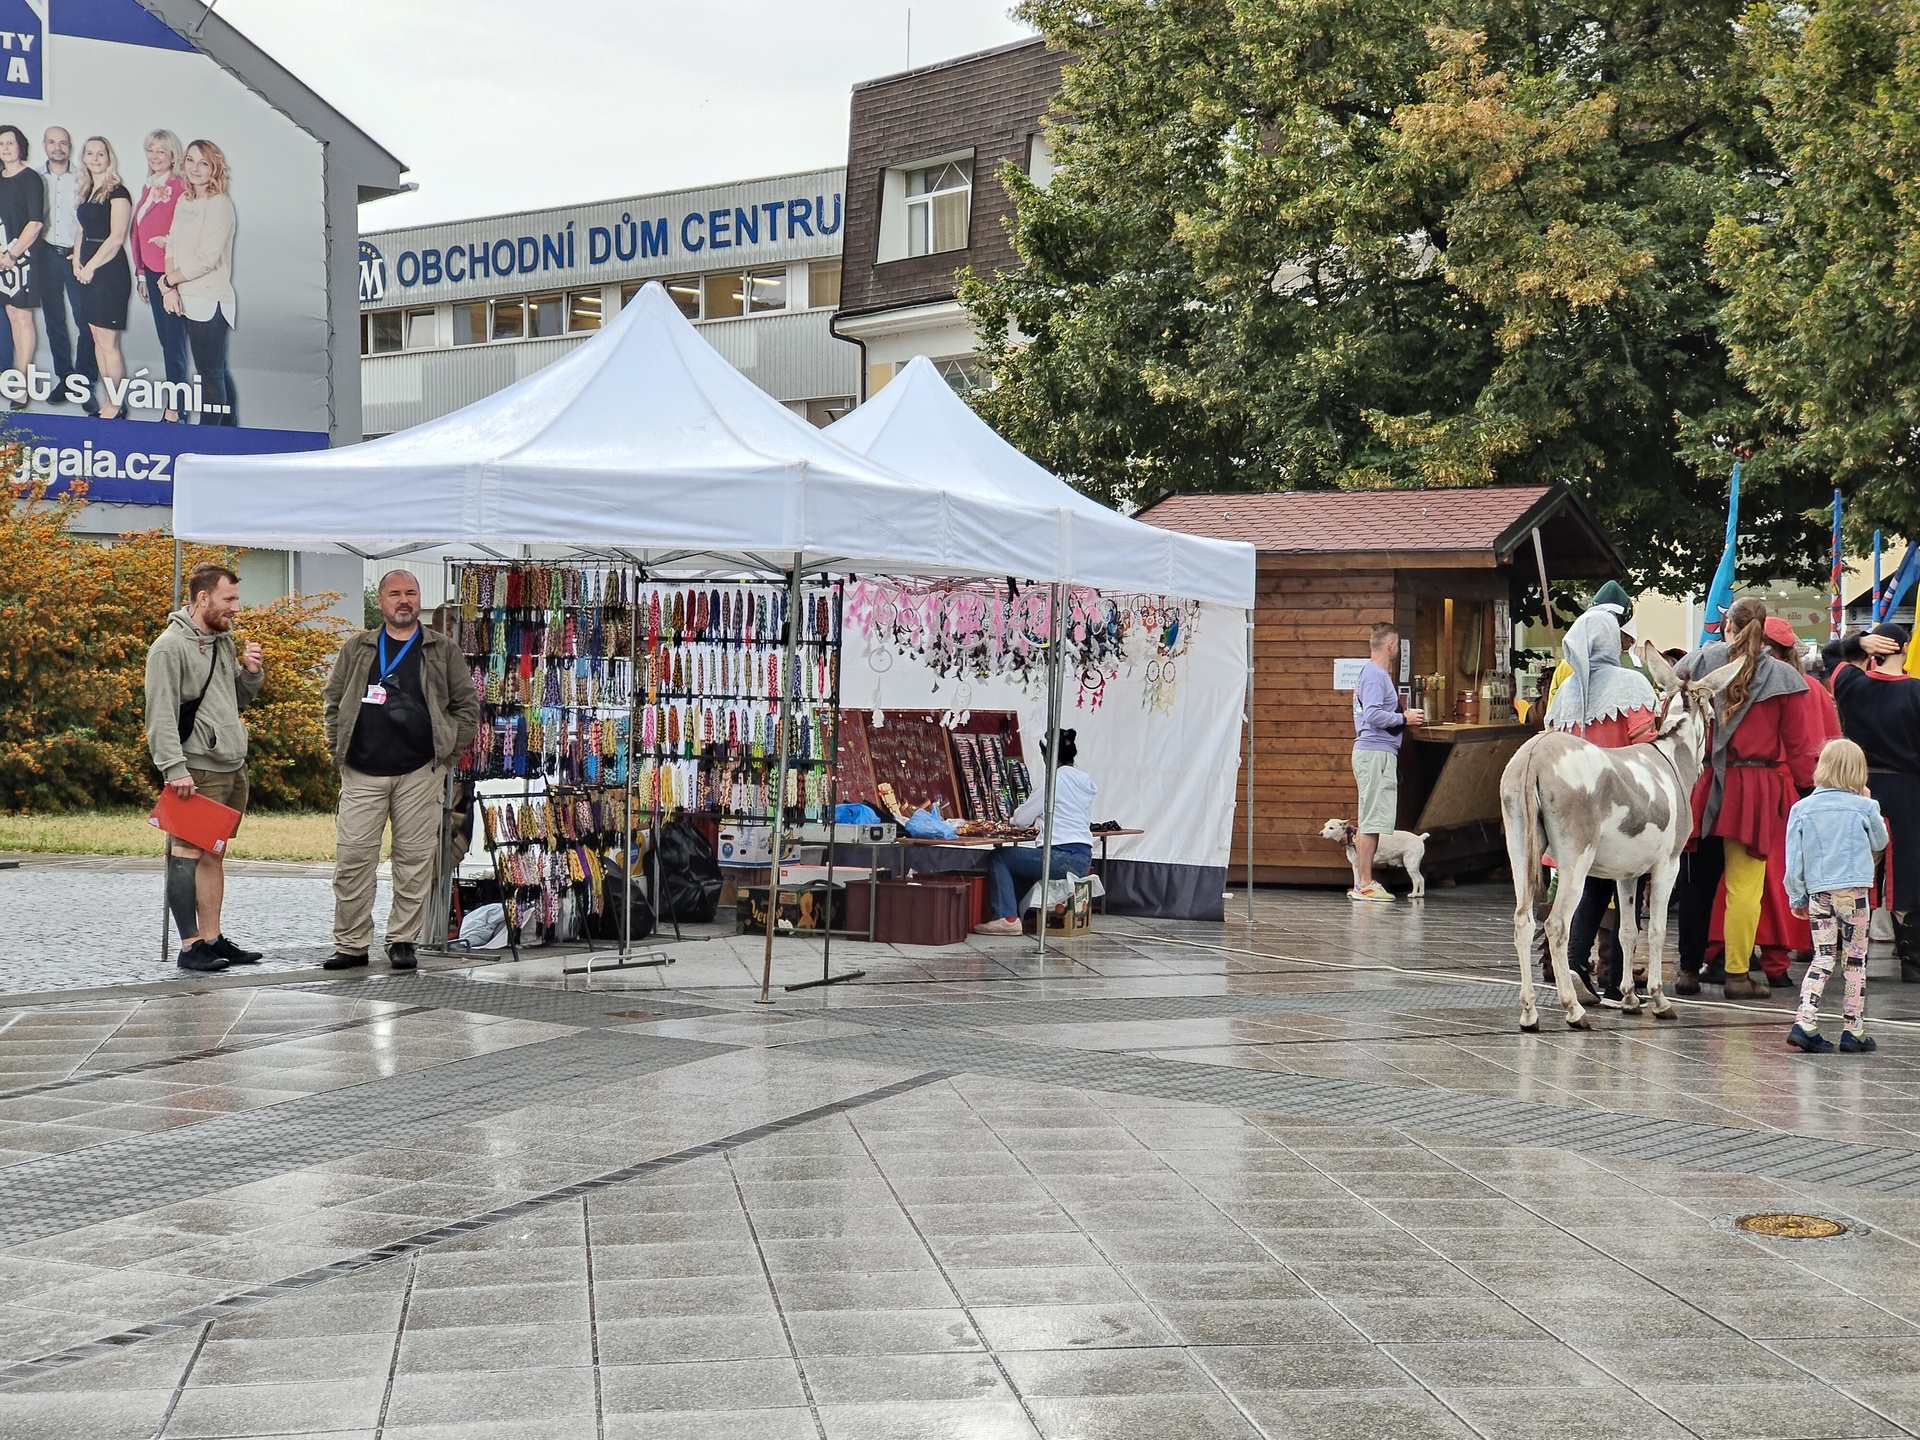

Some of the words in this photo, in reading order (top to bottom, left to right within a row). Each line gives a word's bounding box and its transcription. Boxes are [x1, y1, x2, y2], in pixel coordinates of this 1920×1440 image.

[7, 56, 30, 84] A
[396, 221, 574, 287] OBCHODNÍ
[589, 212, 668, 265] DŮM
[65, 373, 92, 404] s
[103, 367, 231, 414] vámi...
